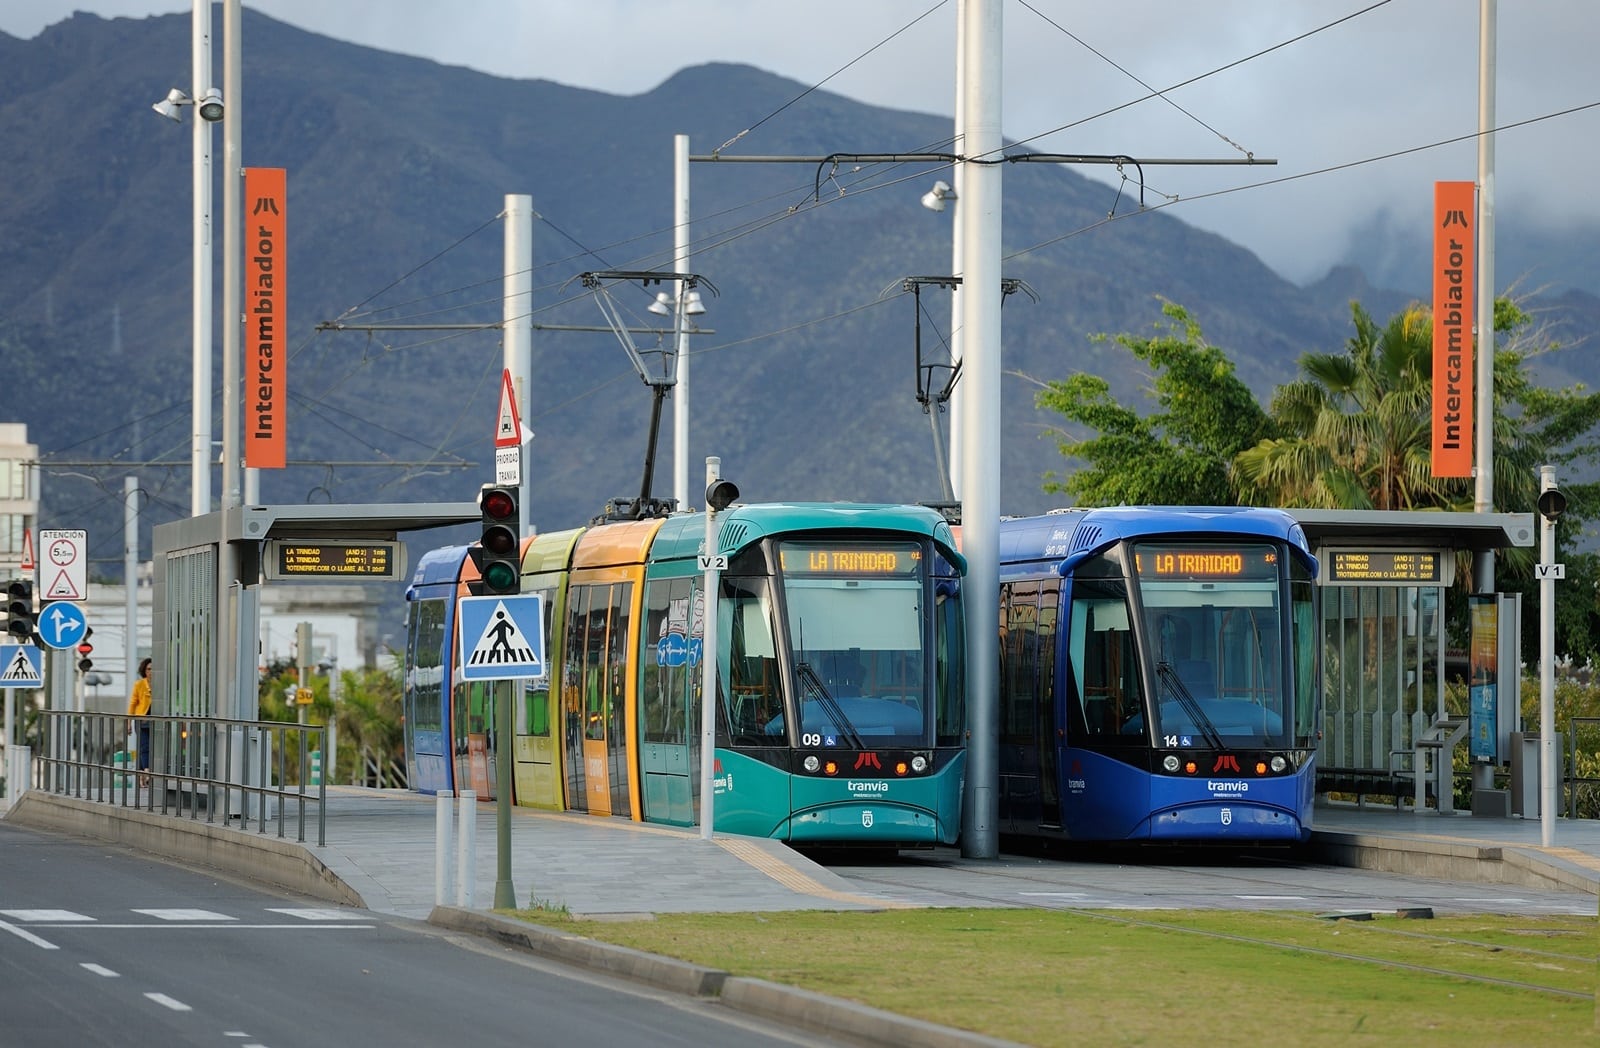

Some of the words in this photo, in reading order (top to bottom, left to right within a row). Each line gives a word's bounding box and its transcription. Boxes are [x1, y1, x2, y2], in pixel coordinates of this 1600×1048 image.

[254, 225, 273, 439] Intercambiador
[1443, 239, 1463, 449] Intercambiador
[496, 452, 518, 464] PRIORIDAD
[701, 557, 711, 568] V
[715, 557, 724, 568] 2
[810, 552, 828, 570] LA
[831, 552, 896, 570] TRINIDAD
[1156, 554, 1174, 573] LA
[1177, 554, 1242, 573] TRINIDAD
[1539, 566, 1549, 576] V
[1553, 566, 1560, 576] 1
[802, 733, 821, 746] 09
[1163, 735, 1178, 747] 14
